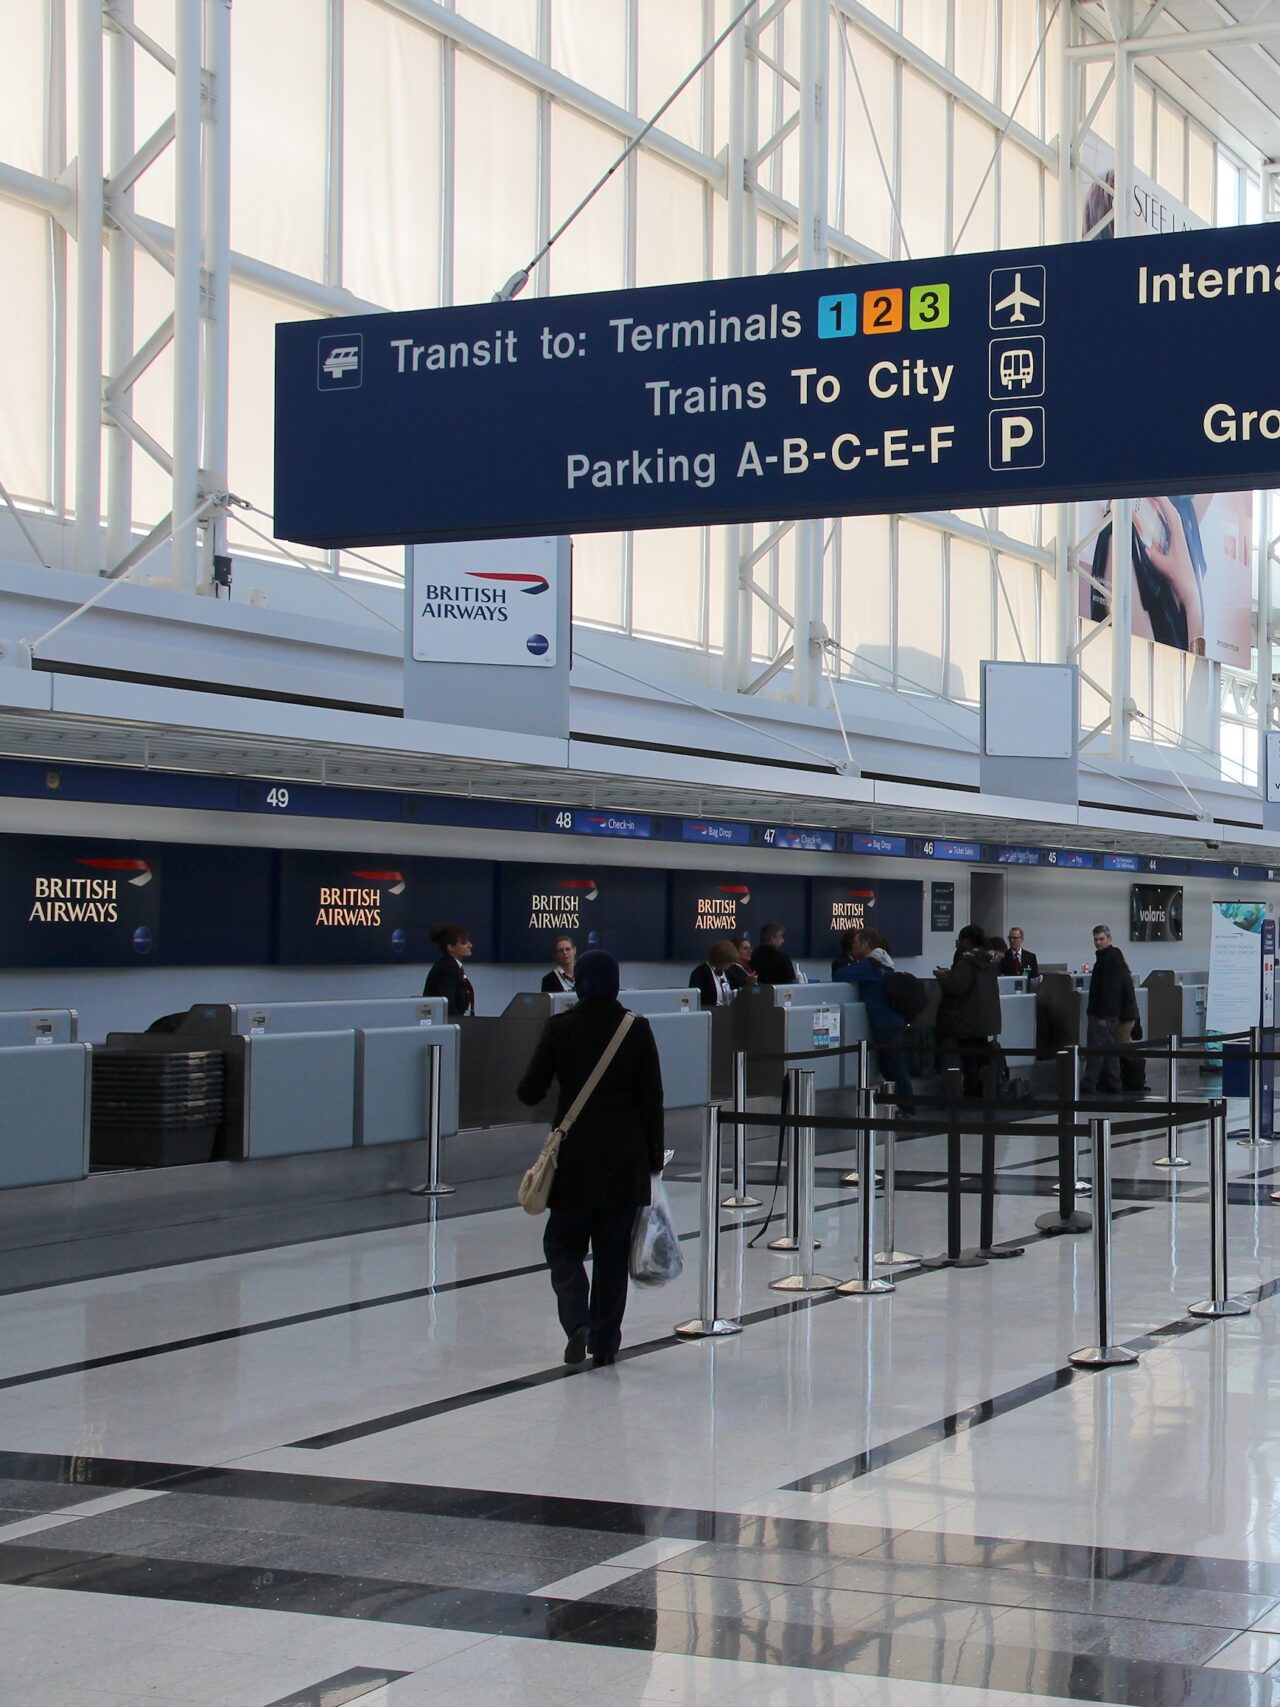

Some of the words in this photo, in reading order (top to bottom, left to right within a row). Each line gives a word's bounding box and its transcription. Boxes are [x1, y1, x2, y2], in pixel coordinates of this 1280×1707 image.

[391, 331, 518, 374] Transit
[540, 325, 587, 360] to:
[610, 303, 802, 355] Terminals
[829, 301, 842, 331] 1
[873, 296, 893, 326] 2
[920, 292, 940, 322] 3
[645, 376, 767, 416] Trains
[790, 367, 841, 405] To
[868, 358, 955, 405] City
[1001, 416, 1034, 463] P
[566, 445, 717, 489] Parking
[736, 425, 956, 479] A-B-C-E-F
[426, 584, 506, 604] BRITISH
[422, 603, 508, 622] AIRWAYS
[266, 787, 289, 808] 49
[556, 812, 572, 829] 48
[608, 818, 635, 831] Check-in
[708, 827, 718, 837] Bag
[719, 828, 732, 839] Drop
[764, 828, 775, 843] 47
[873, 840, 881, 849] Bag
[881, 840, 892, 851] Drop
[923, 842, 934, 855] 46
[1048, 852, 1057, 864] 45
[1149, 860, 1157, 871] 44
[1233, 866, 1239, 877] 43
[35, 877, 117, 900] BRITISH
[320, 887, 380, 907] BRITISH
[531, 894, 579, 912] BRITISH
[698, 898, 736, 914] BRITISH
[832, 902, 864, 916] BRITISH
[29, 901, 118, 923] AIRWAYS
[315, 908, 381, 926] AIRWAYS
[528, 912, 580, 929] AIRWAYS
[1140, 905, 1165, 922] volaris
[695, 914, 736, 930] AIRWAYS
[830, 917, 864, 930] AIRWAYS
